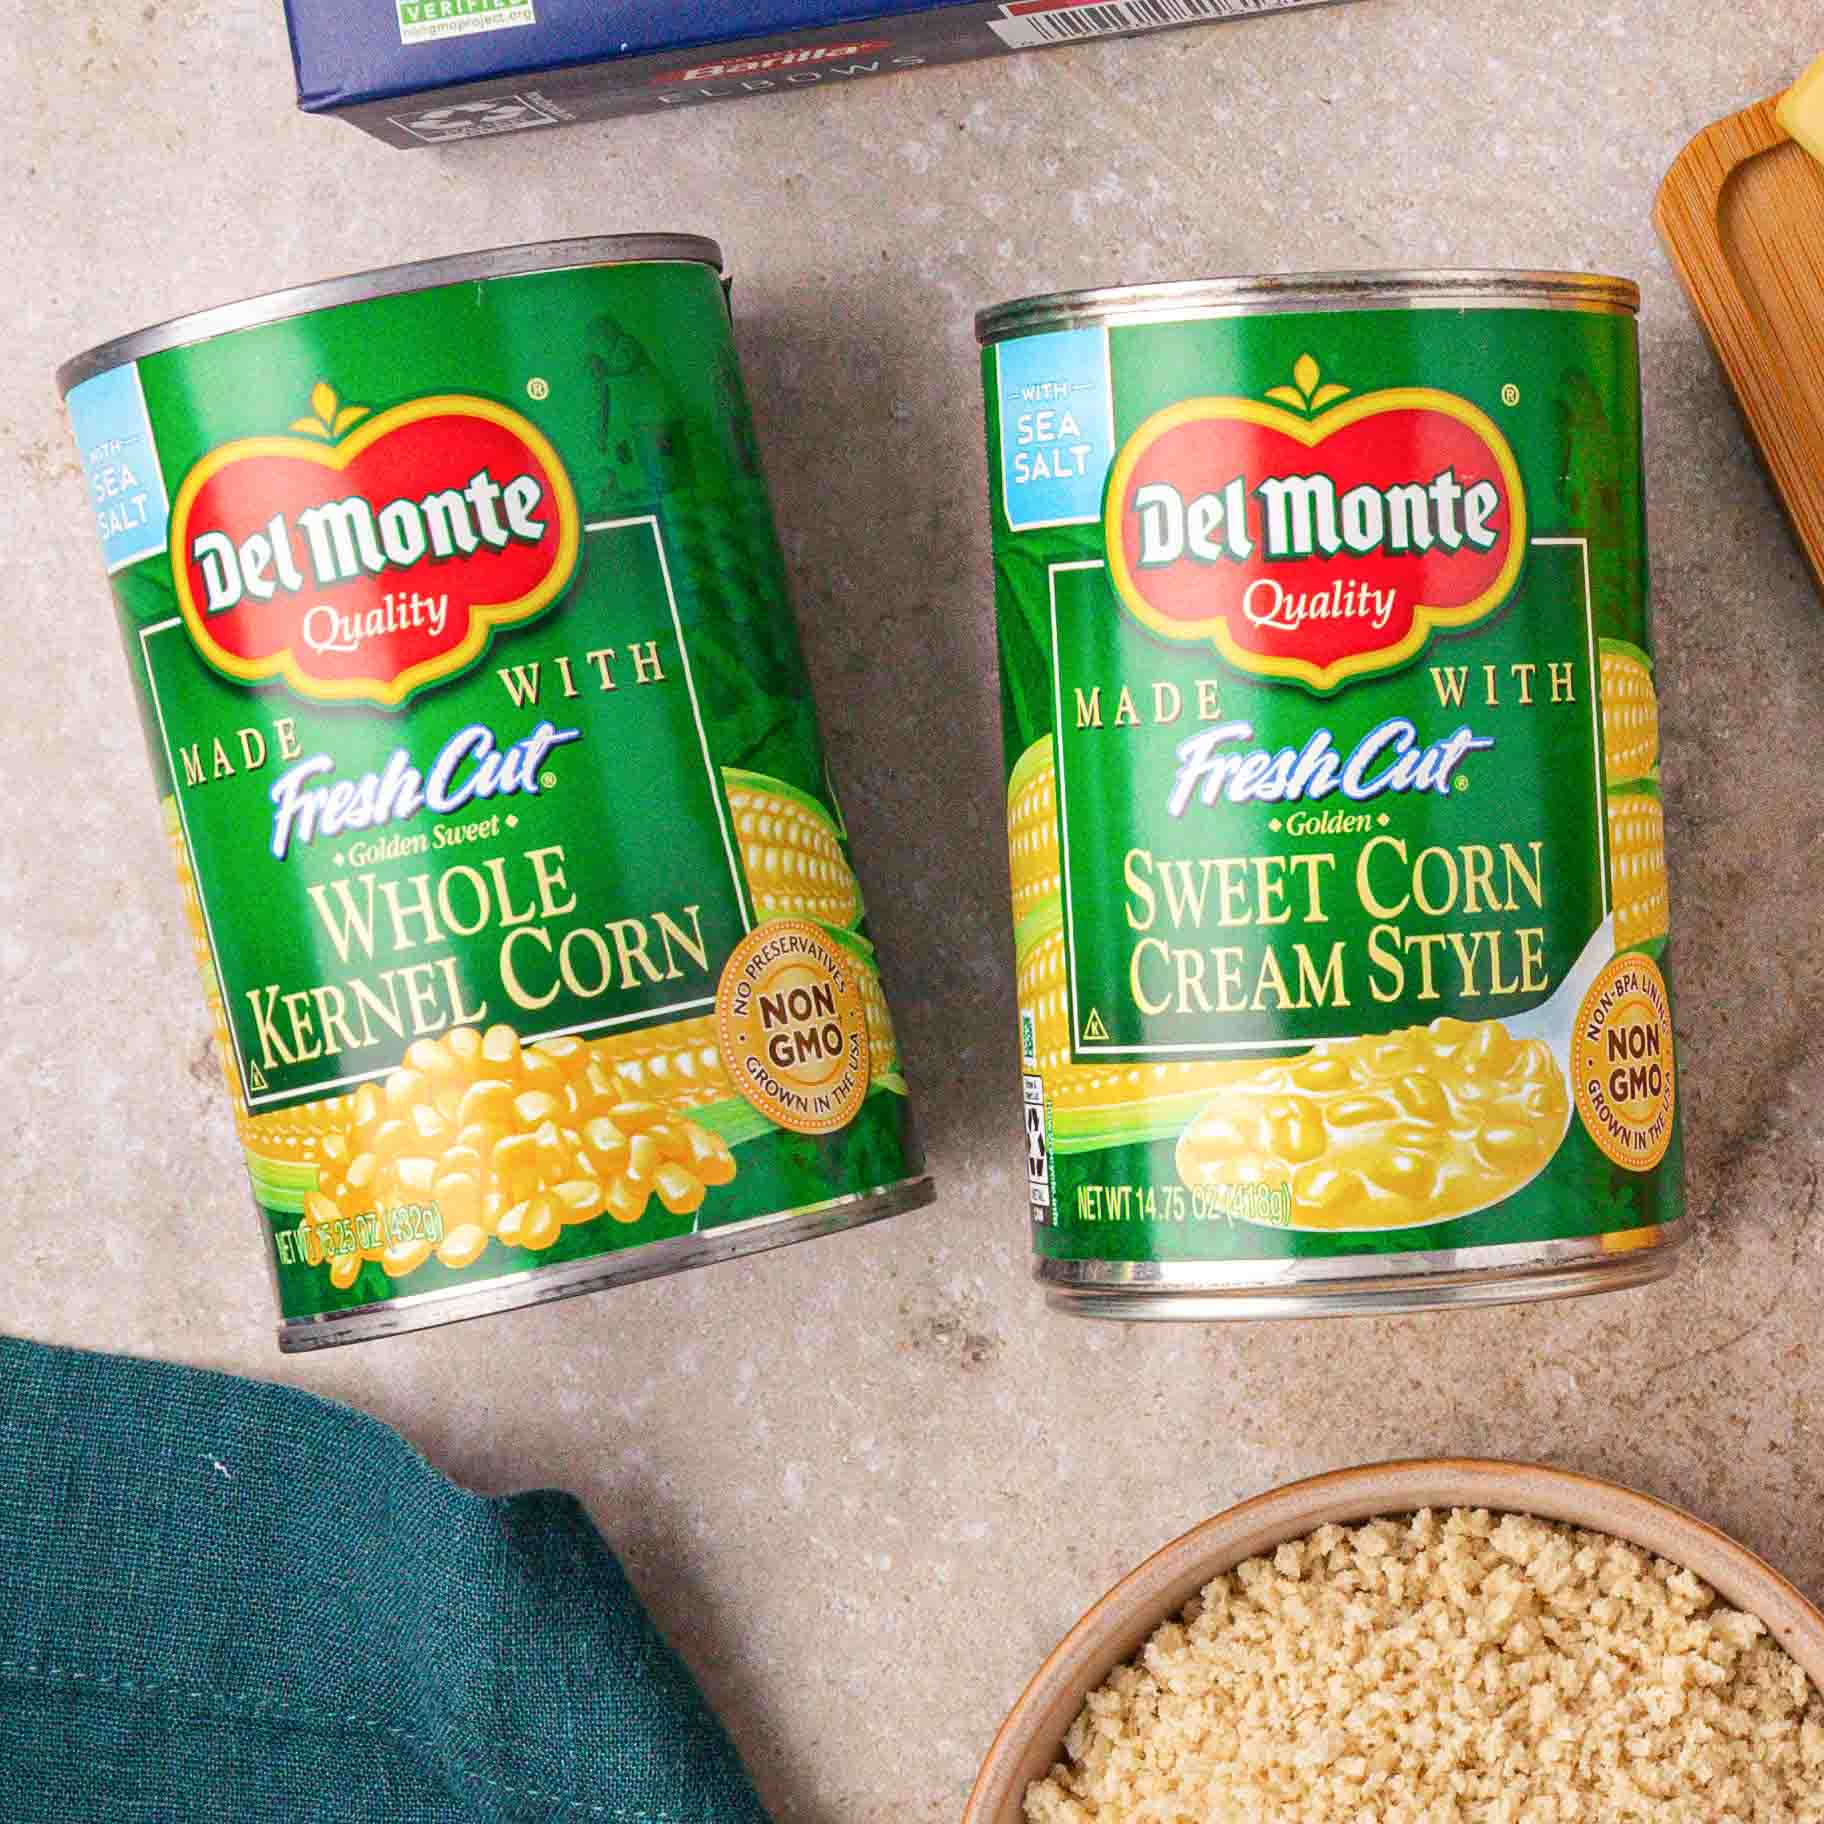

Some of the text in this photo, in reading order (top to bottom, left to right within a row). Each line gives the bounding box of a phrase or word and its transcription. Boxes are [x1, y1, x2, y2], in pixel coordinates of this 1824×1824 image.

[1017, 410, 1080, 445] SEA
[1015, 444, 1091, 484] SALT
[192, 468, 548, 614] Del Monte
[1133, 467, 1501, 568] Del Monte
[302, 591, 450, 655] Quality
[1242, 579, 1397, 629] Quality
[180, 641, 667, 789] MADE WITH
[1074, 661, 1576, 729] MADE WITH
[268, 719, 581, 859] Fresh Cut
[1168, 717, 1495, 816] Fresh Cut
[347, 816, 502, 870] Golden Sweet
[1286, 809, 1373, 837] Golden
[307, 844, 578, 966] WHOLE
[1123, 835, 1544, 931] SWEET CORN
[245, 904, 712, 1072] KERNEL CORN
[1129, 925, 1550, 1016] CREAM STYLE
[759, 983, 835, 1029] NON
[768, 1023, 843, 1068] GMO
[1607, 1023, 1660, 1062] NON
[745, 1056, 808, 1113] GROWN
[1588, 1080, 1631, 1147] GROWN
[1609, 1063, 1662, 1102] GMO
[1077, 1185, 1185, 1221] NET WT 14.75
